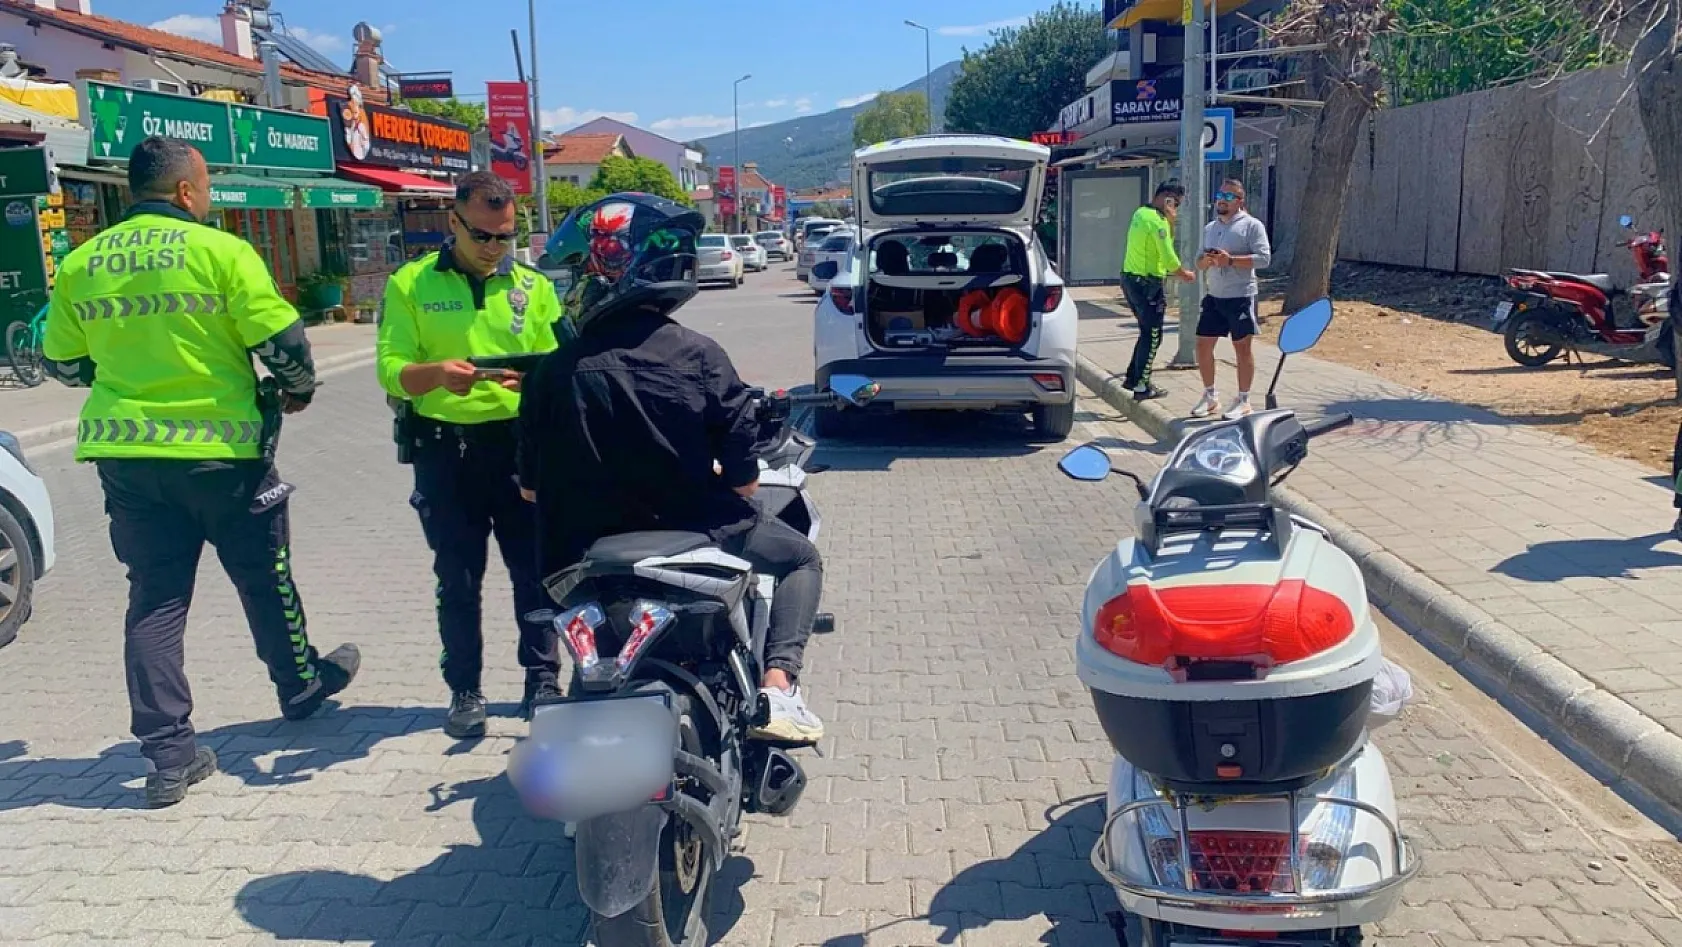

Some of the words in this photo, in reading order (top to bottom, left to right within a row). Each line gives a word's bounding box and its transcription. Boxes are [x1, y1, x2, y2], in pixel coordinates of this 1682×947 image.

[1114, 100, 1151, 114] SARAY
[1154, 99, 1179, 112] CAM
[143, 111, 162, 136] ÖZ
[165, 119, 214, 142] MARKET
[268, 126, 283, 149] ÖZ
[284, 132, 320, 152] MARKET
[372, 111, 421, 143] MERKEZ
